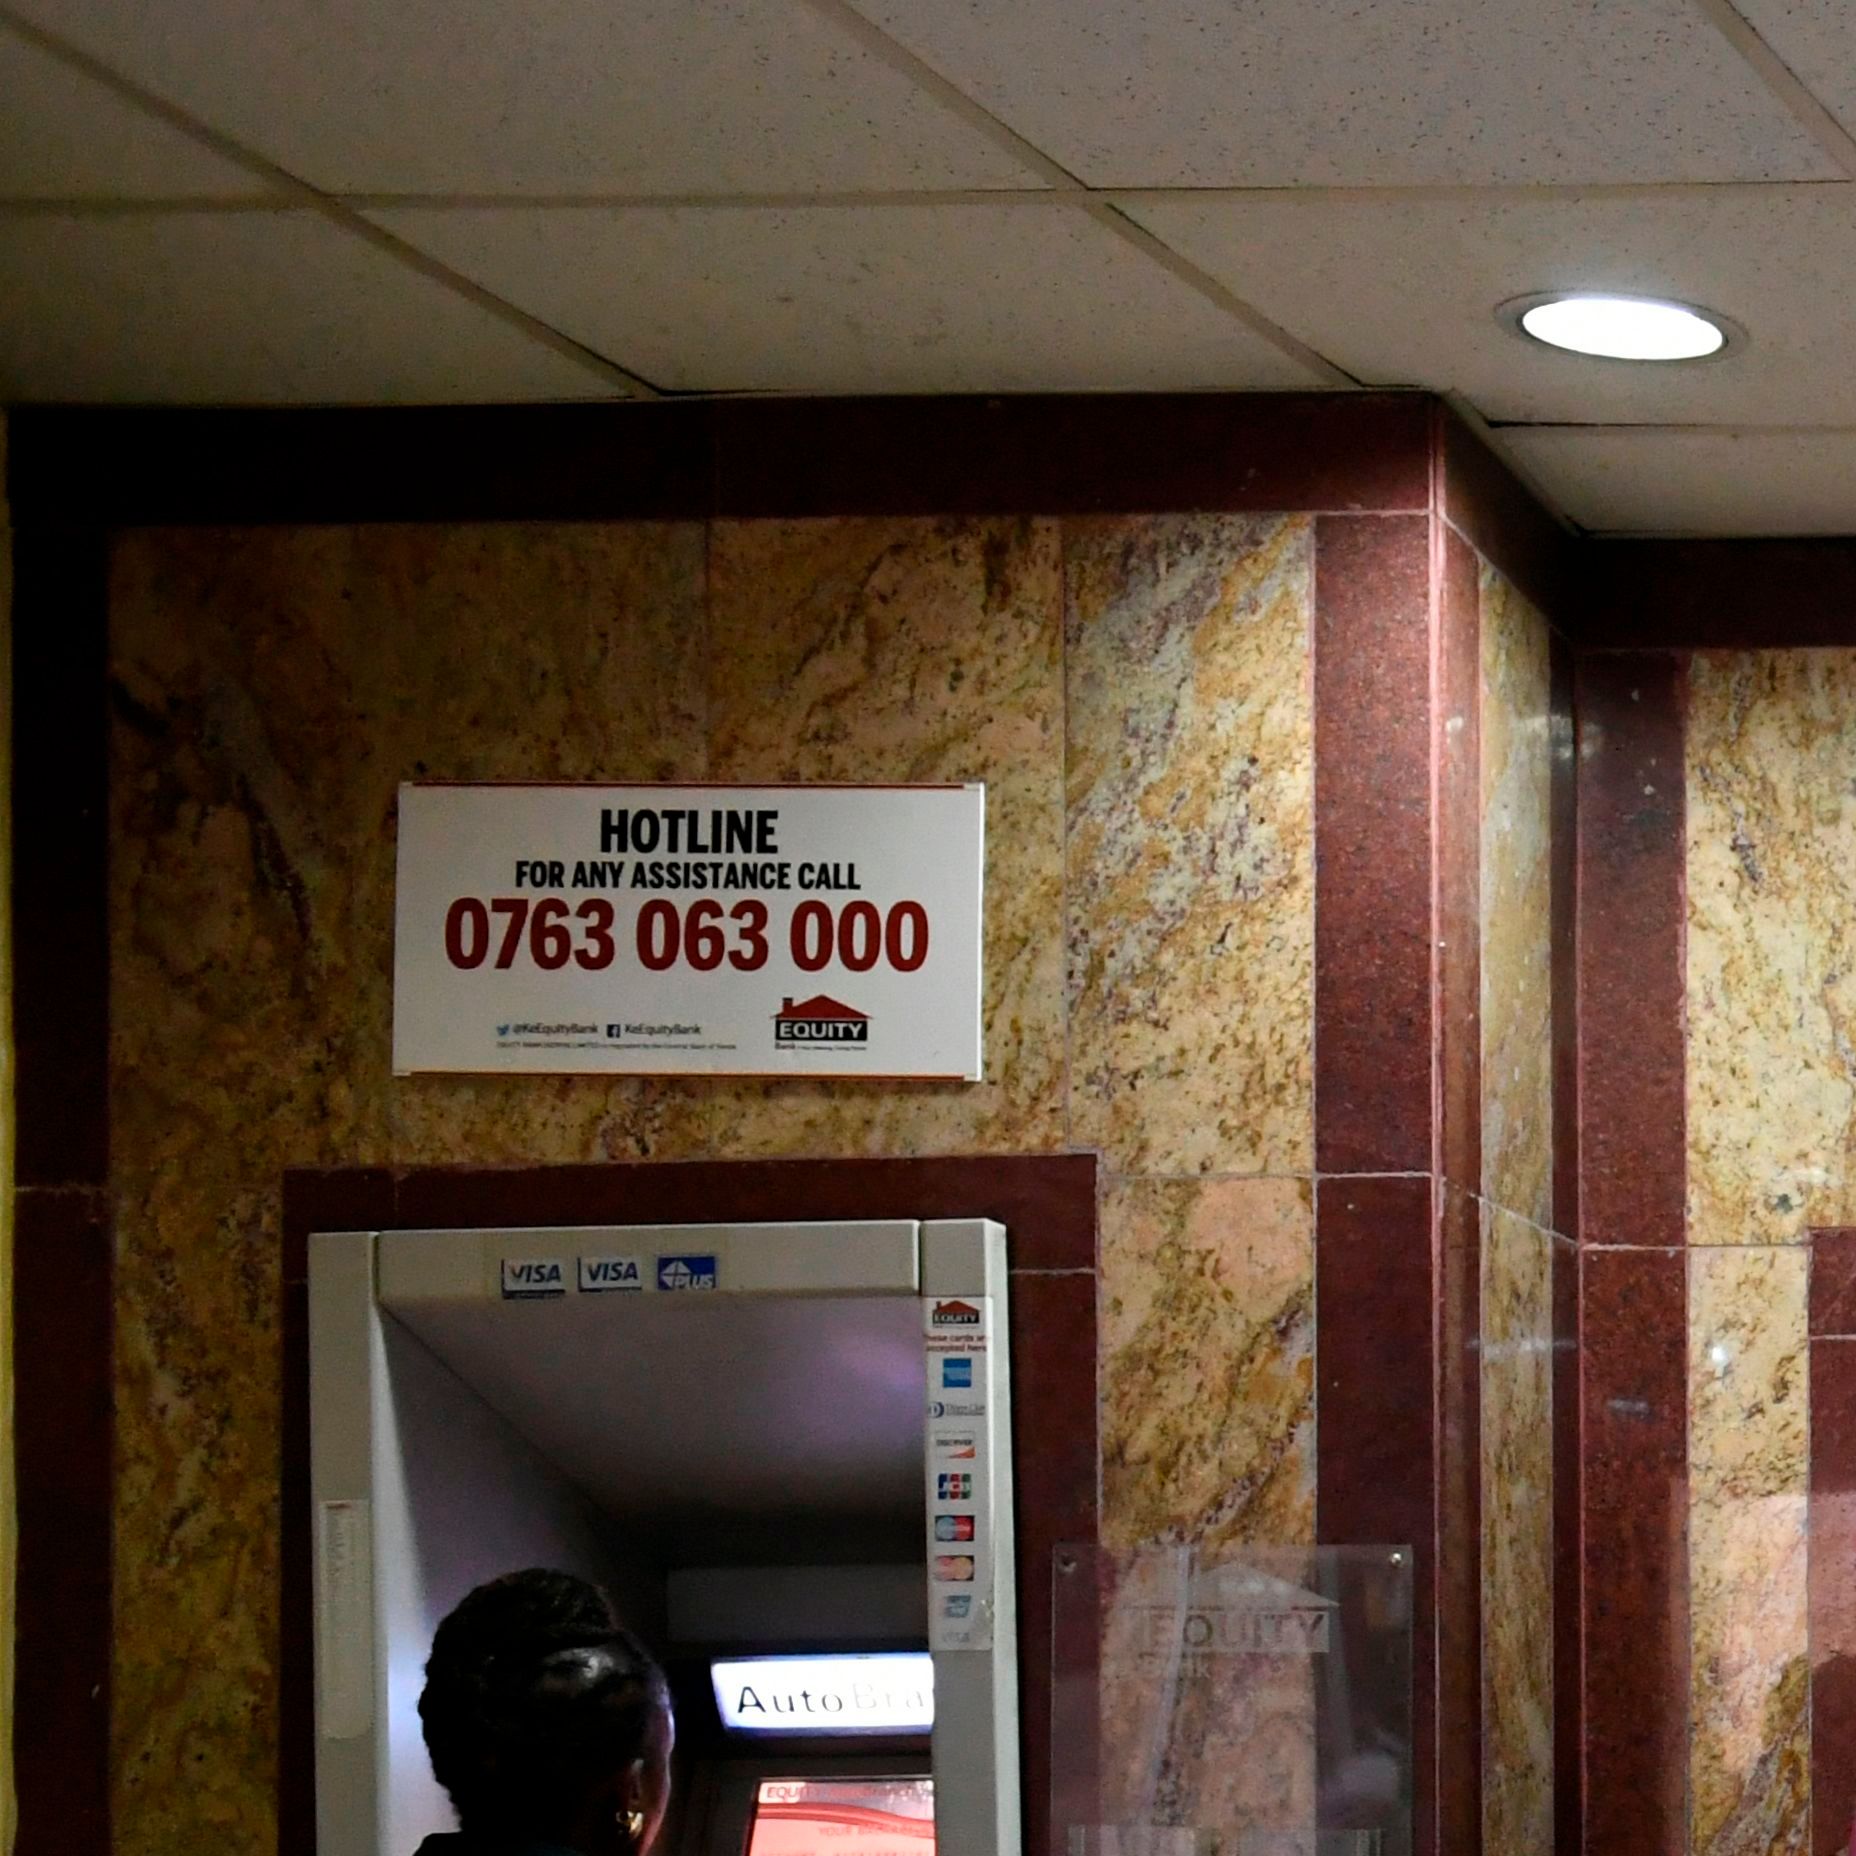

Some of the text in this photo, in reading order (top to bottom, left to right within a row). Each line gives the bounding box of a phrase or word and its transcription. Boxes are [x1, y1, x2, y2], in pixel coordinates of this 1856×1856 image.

[600, 809, 778, 854] HOTLINE
[516, 861, 861, 890] FOR ANY ASSISTANCE CALL
[445, 897, 928, 972] 0763 063 000
[513, 1023, 598, 1035] @KeEquityBank
[625, 1023, 701, 1036] KeEquityBank
[779, 1022, 864, 1040] EQUITY
[511, 1262, 713, 1289] VISA VISA PLUS
